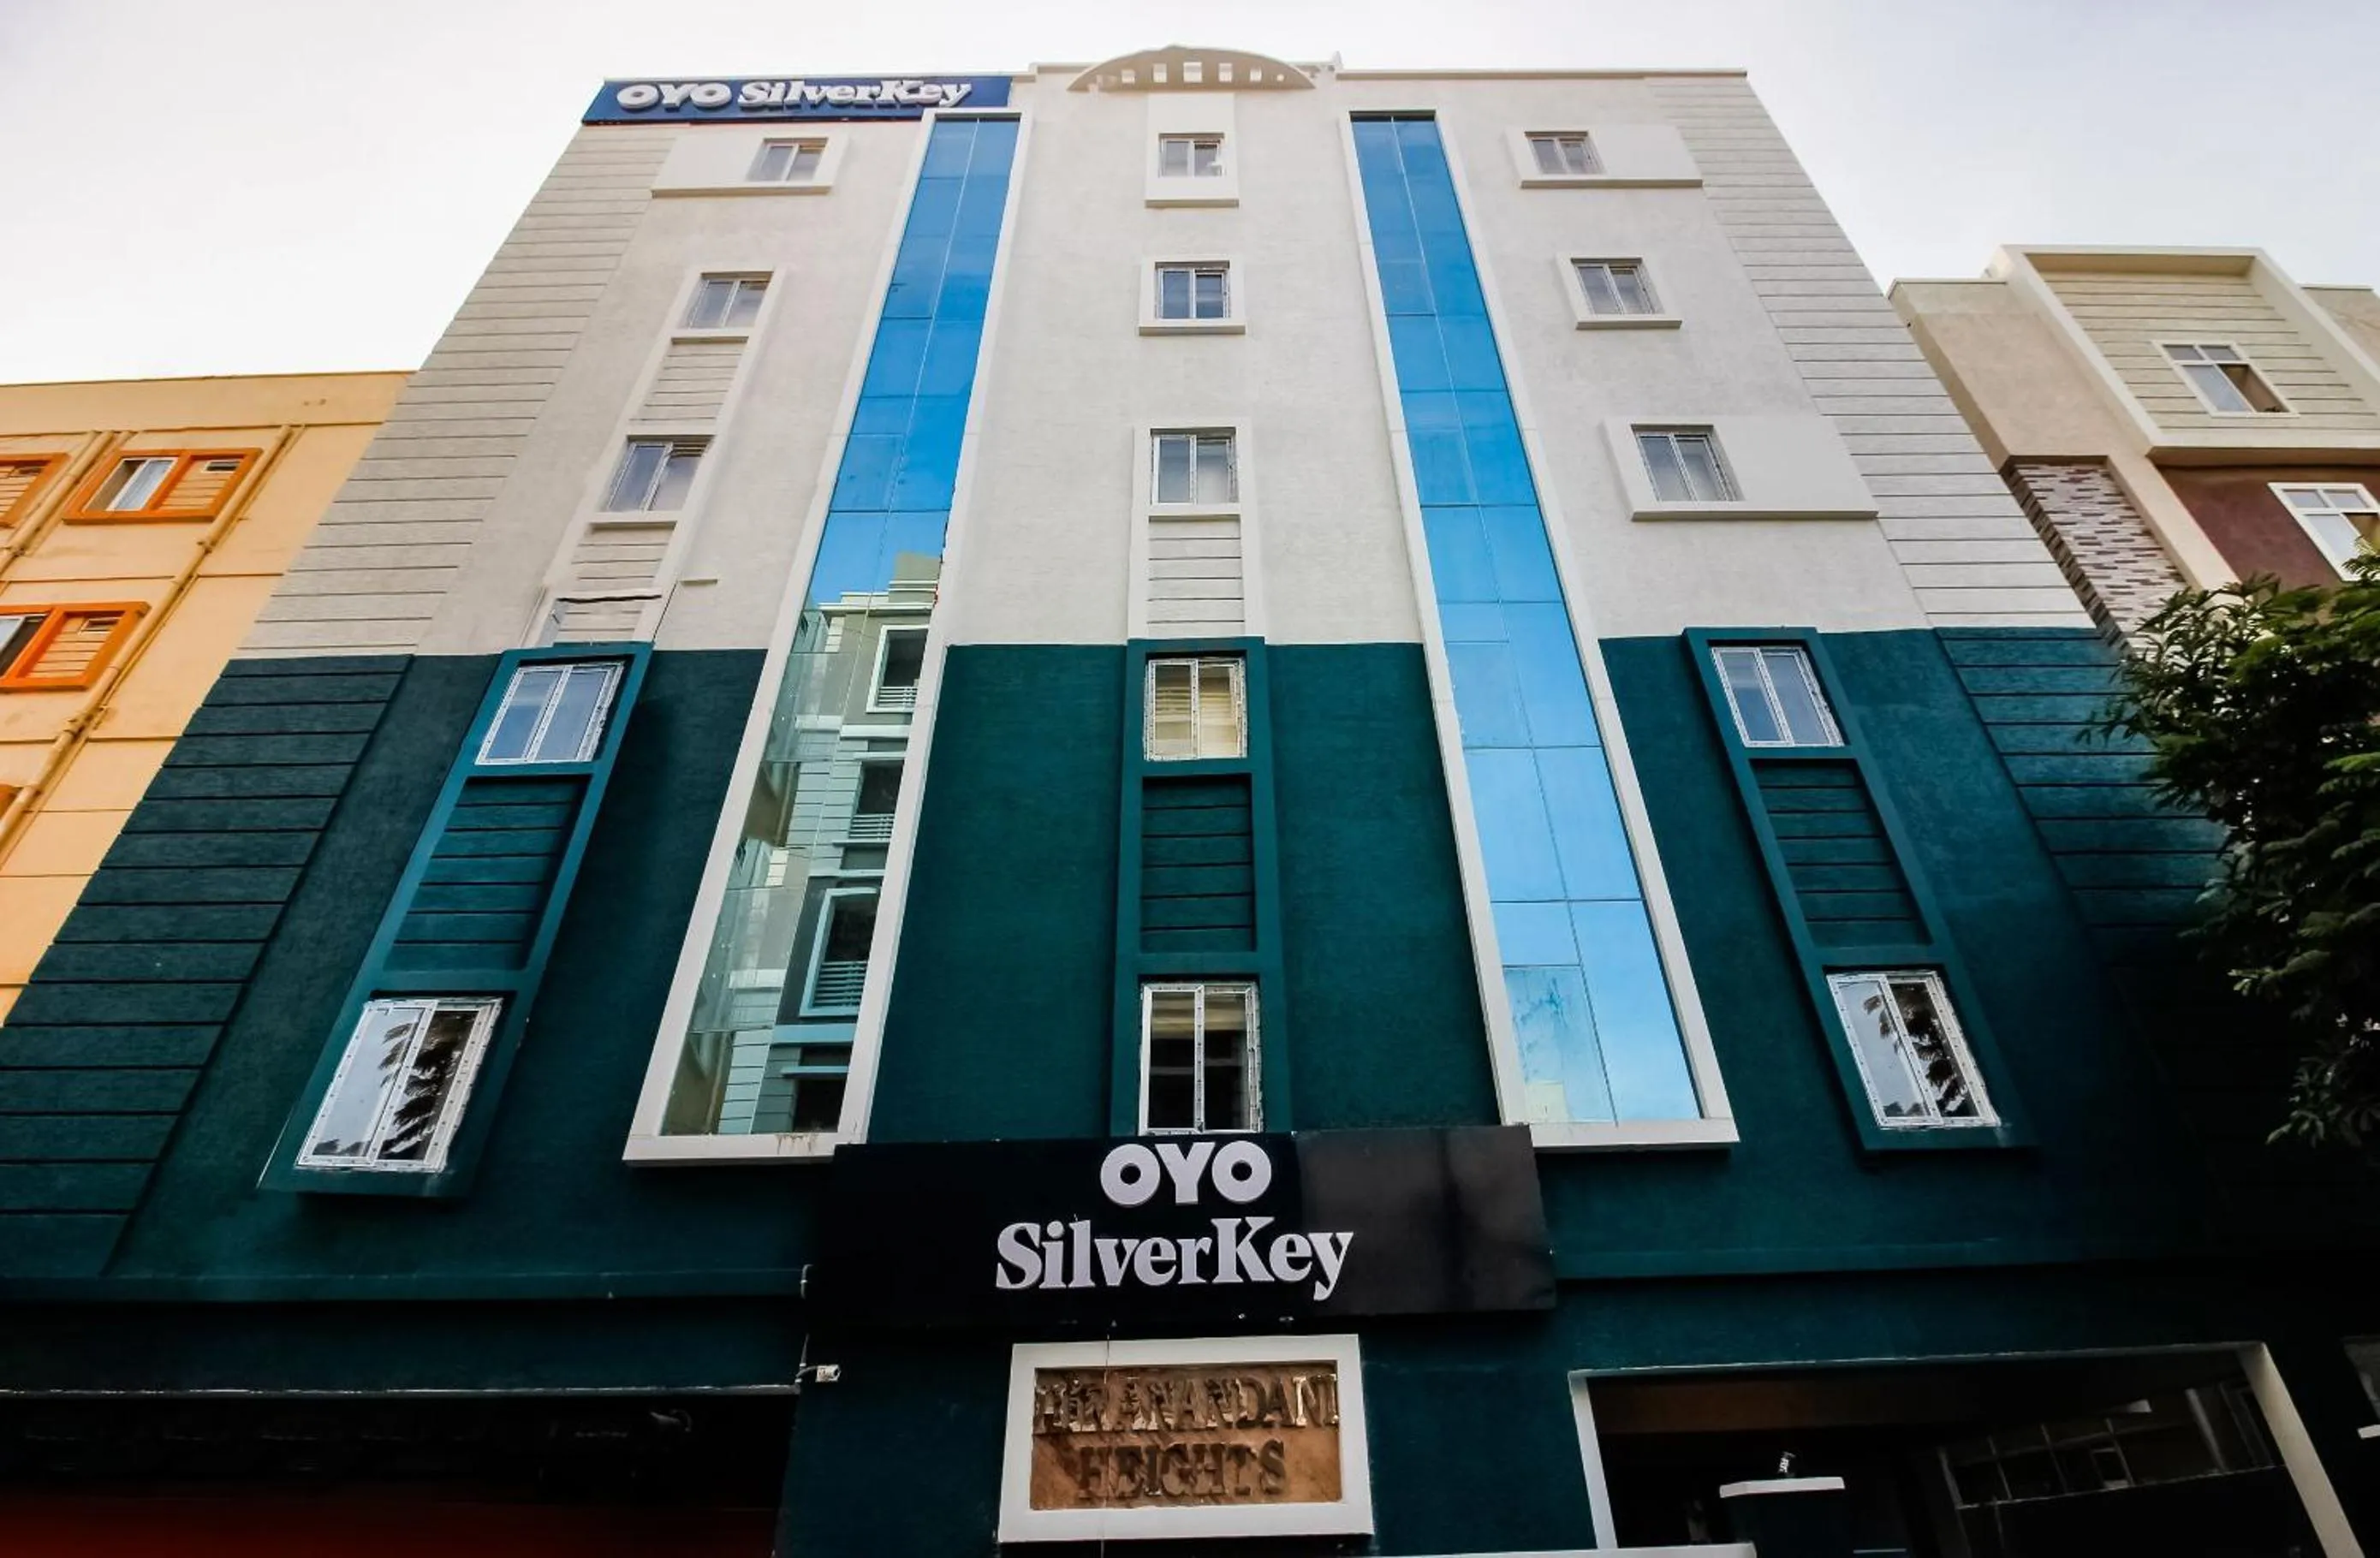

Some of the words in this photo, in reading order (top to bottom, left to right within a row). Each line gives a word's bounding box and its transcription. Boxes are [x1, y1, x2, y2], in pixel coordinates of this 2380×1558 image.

[616, 82, 731, 111] OYO
[738, 80, 973, 109] SilverKey
[1099, 1140, 1272, 1207] OYO
[996, 1216, 1354, 1301] SilverKey
[1077, 1440, 1287, 1498] HEIGHTS
